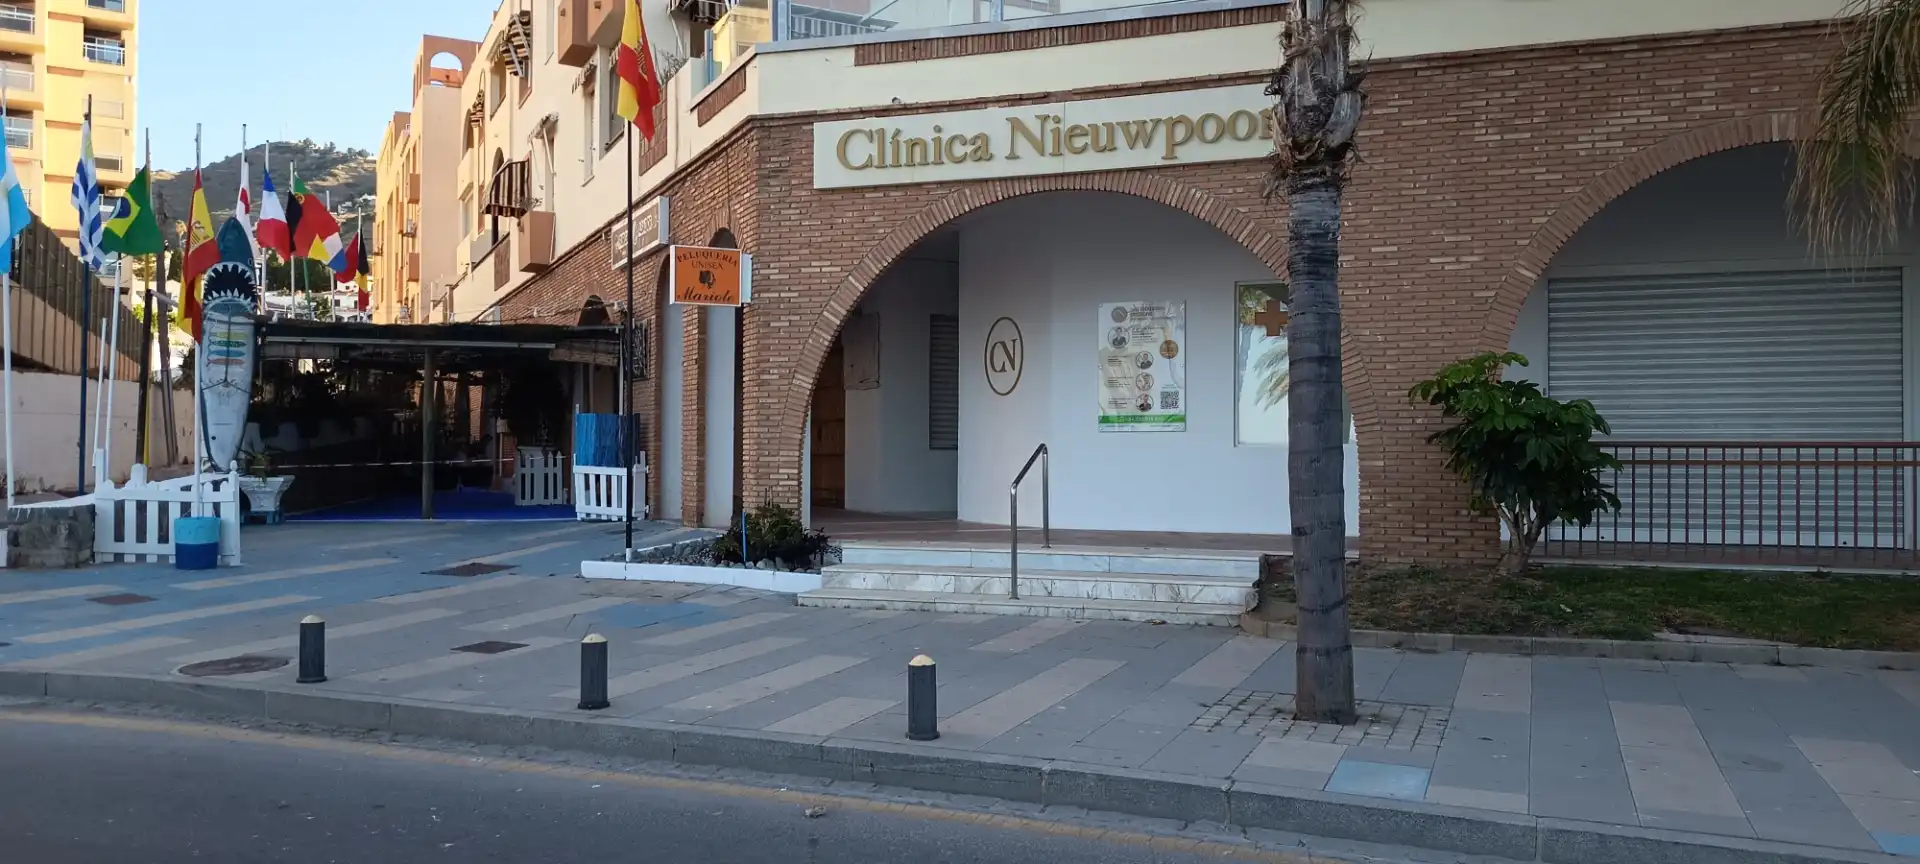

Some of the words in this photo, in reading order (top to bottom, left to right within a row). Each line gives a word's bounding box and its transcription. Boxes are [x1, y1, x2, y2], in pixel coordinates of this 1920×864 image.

[836, 124, 994, 170] Clínica
[1005, 107, 1274, 160] Nieuwpoor
[691, 260, 724, 270] UNISEX
